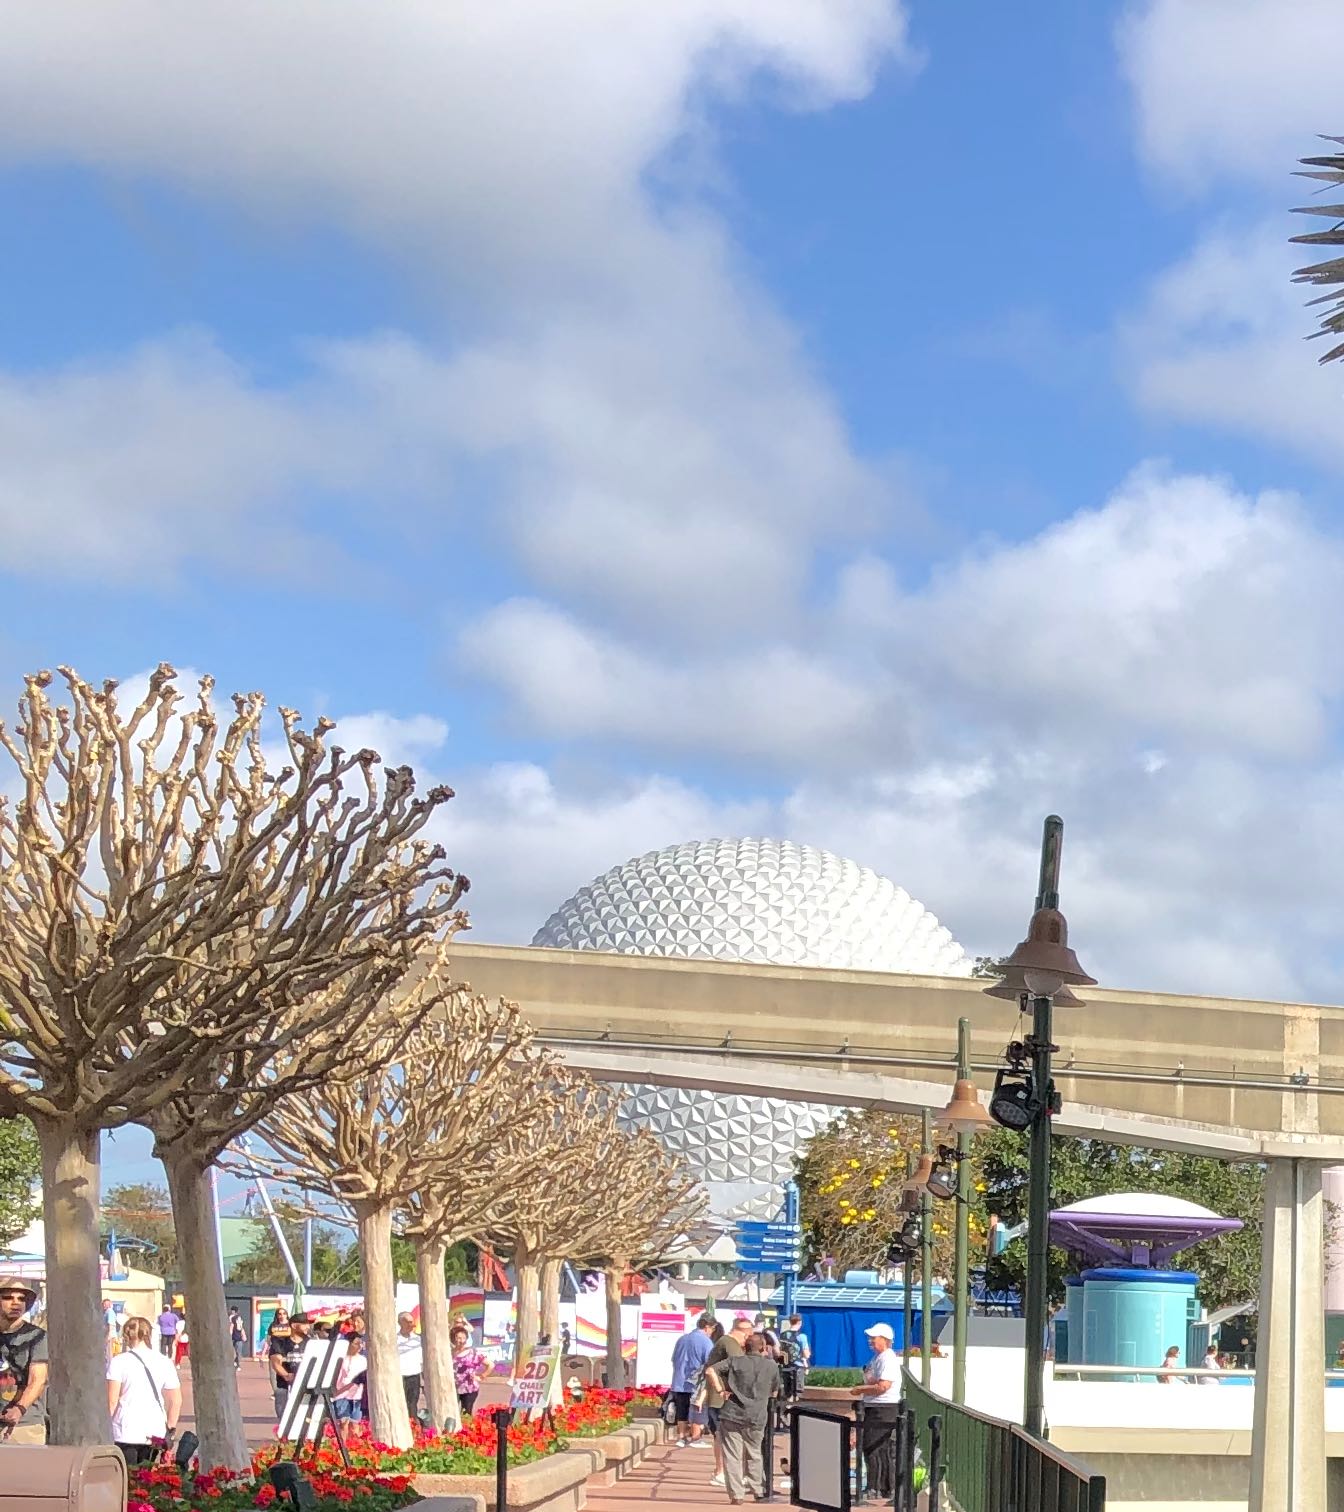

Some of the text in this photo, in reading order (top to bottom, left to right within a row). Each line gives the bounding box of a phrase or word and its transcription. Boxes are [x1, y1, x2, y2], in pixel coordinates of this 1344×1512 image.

[524, 1361, 550, 1380] 2D
[519, 1381, 546, 1390] CHALK
[516, 1391, 544, 1404] ART
